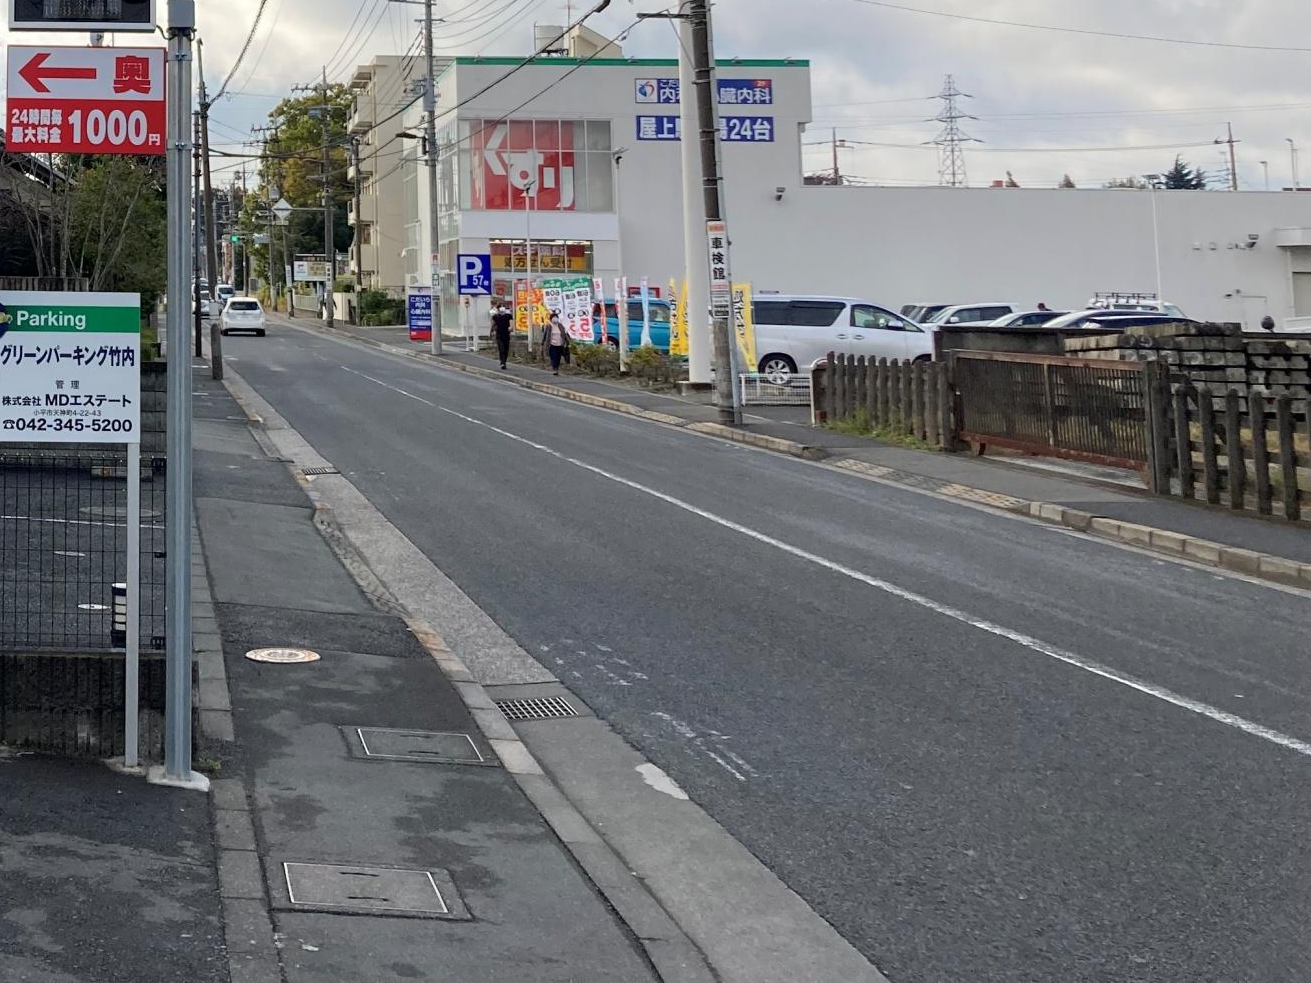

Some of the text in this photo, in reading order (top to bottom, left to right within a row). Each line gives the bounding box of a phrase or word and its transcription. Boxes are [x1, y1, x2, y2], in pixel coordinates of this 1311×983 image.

[113, 55, 151, 94] 奥
[11, 126, 62, 143] 最大料金
[483, 124, 574, 208] くすり
[459, 256, 482, 286] P
[17, 310, 86, 330] Parking
[0, 345, 135, 367] グリーンパーキング竹内
[2, 393, 132, 407] 株式会社 MDエステート
[15, 418, 133, 432] 042-345-5200
